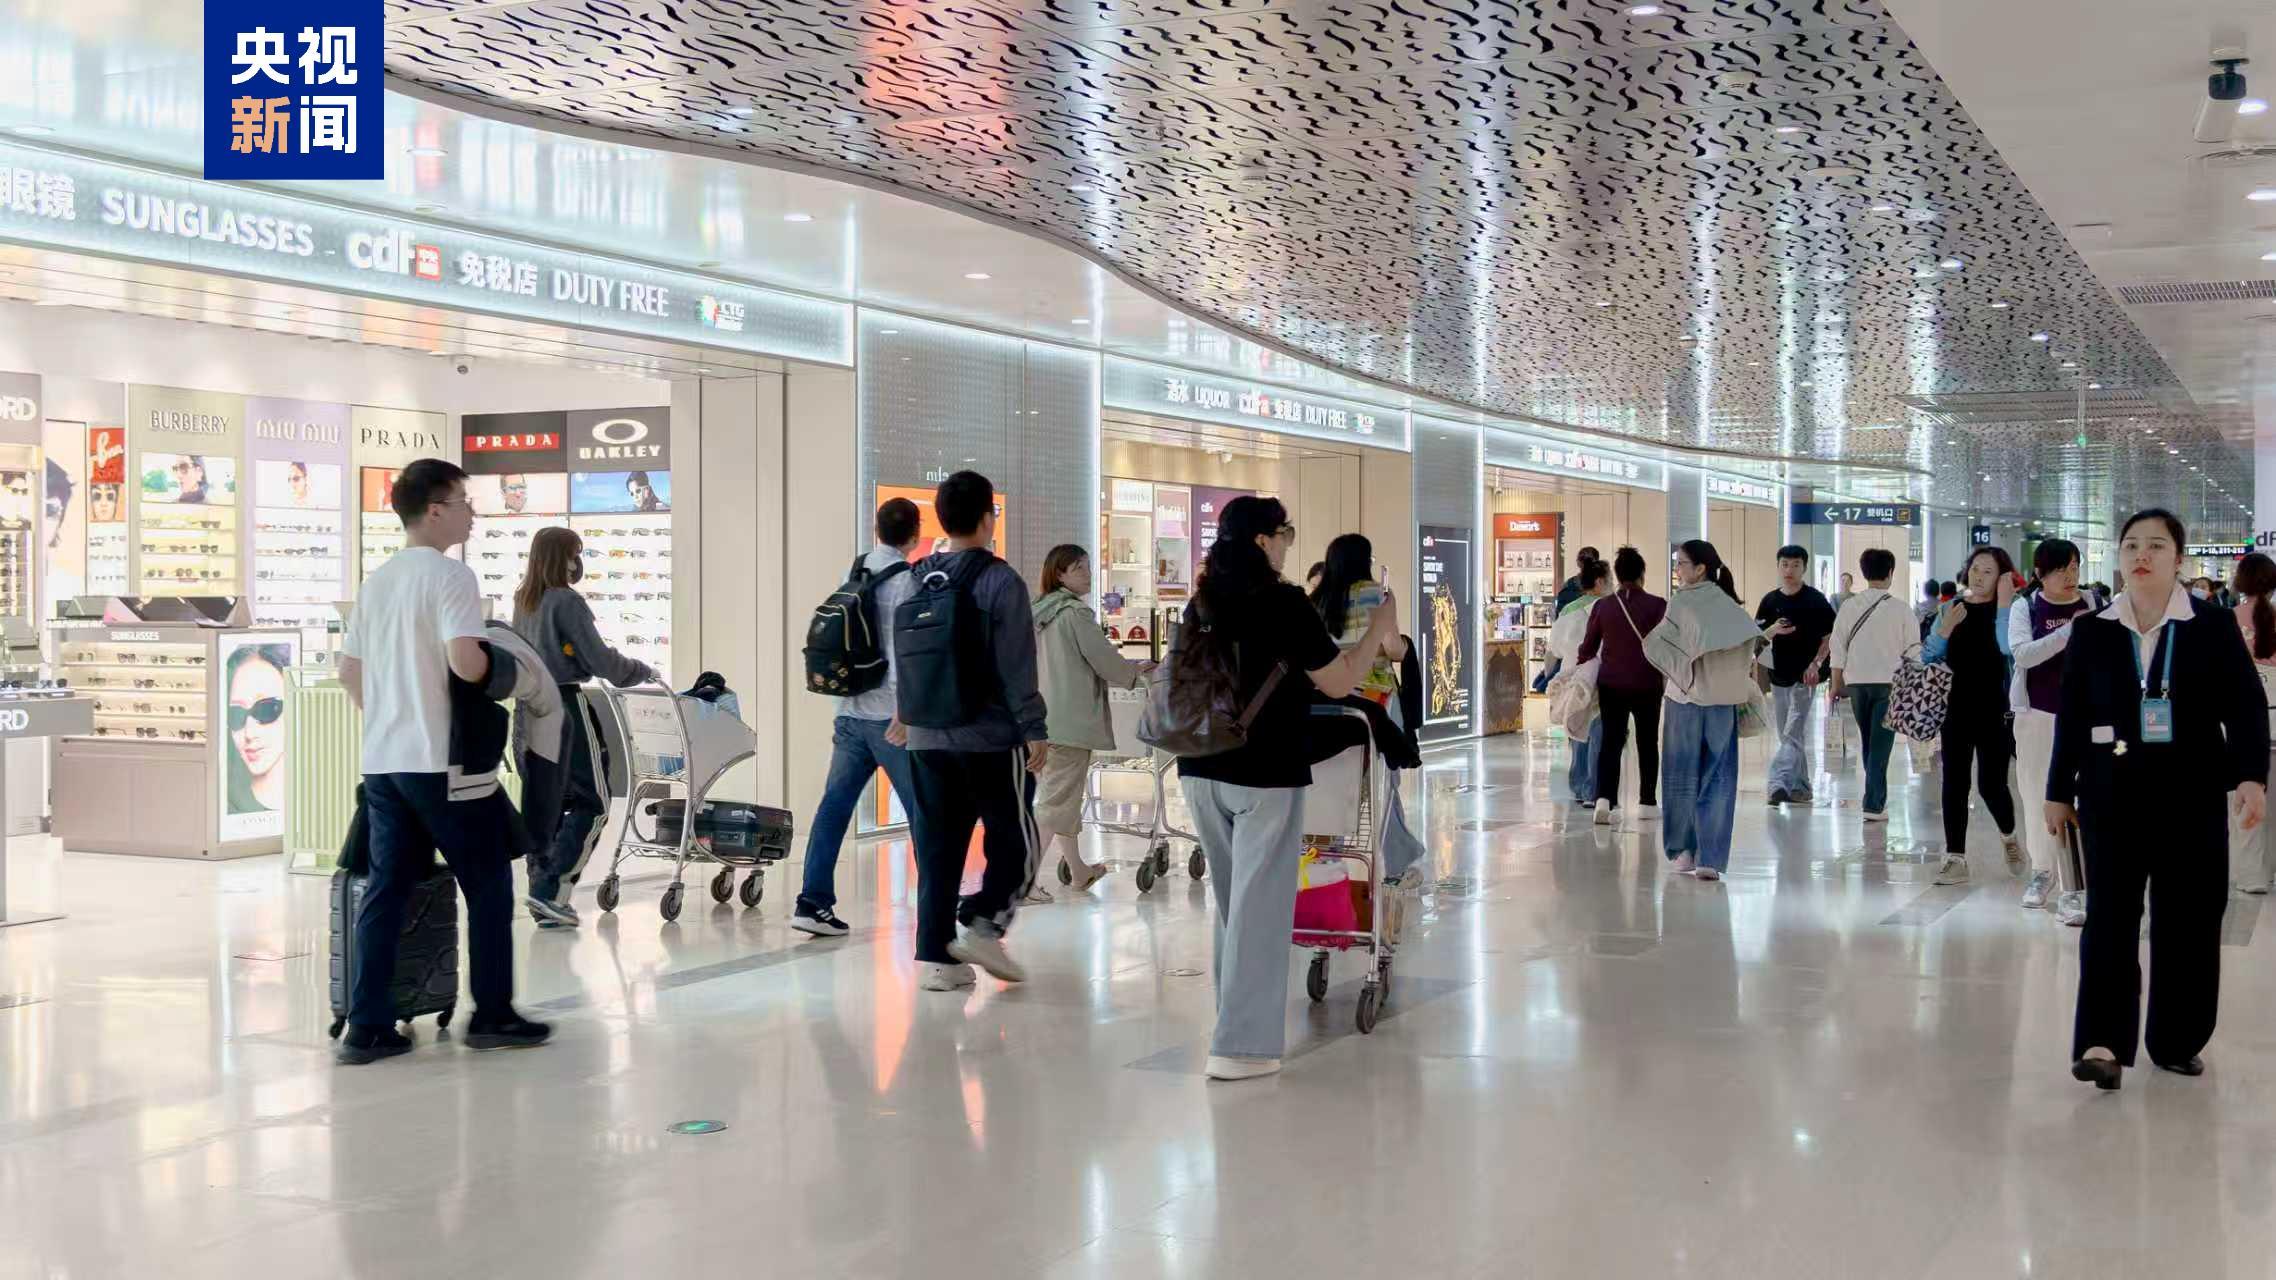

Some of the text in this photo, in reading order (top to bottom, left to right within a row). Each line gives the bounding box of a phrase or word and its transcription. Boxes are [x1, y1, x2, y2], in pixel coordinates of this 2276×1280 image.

[101, 187, 314, 257] SUNGLASSES
[459, 250, 538, 297] 免税店
[553, 270, 617, 308] DUTY
[619, 281, 671, 318] FREE
[0, 396, 37, 421] RD
[1194, 385, 1231, 409] LIQUOR
[1305, 405, 1328, 427] DUTY
[1328, 409, 1348, 429] FREE
[150, 409, 230, 434] BURBERRY
[360, 427, 441, 449] PRADA
[476, 433, 553, 448] PRADA
[579, 445, 661, 459] OAKLEY
[1843, 508, 1861, 521] 17
[1975, 531, 1989, 543] 16
